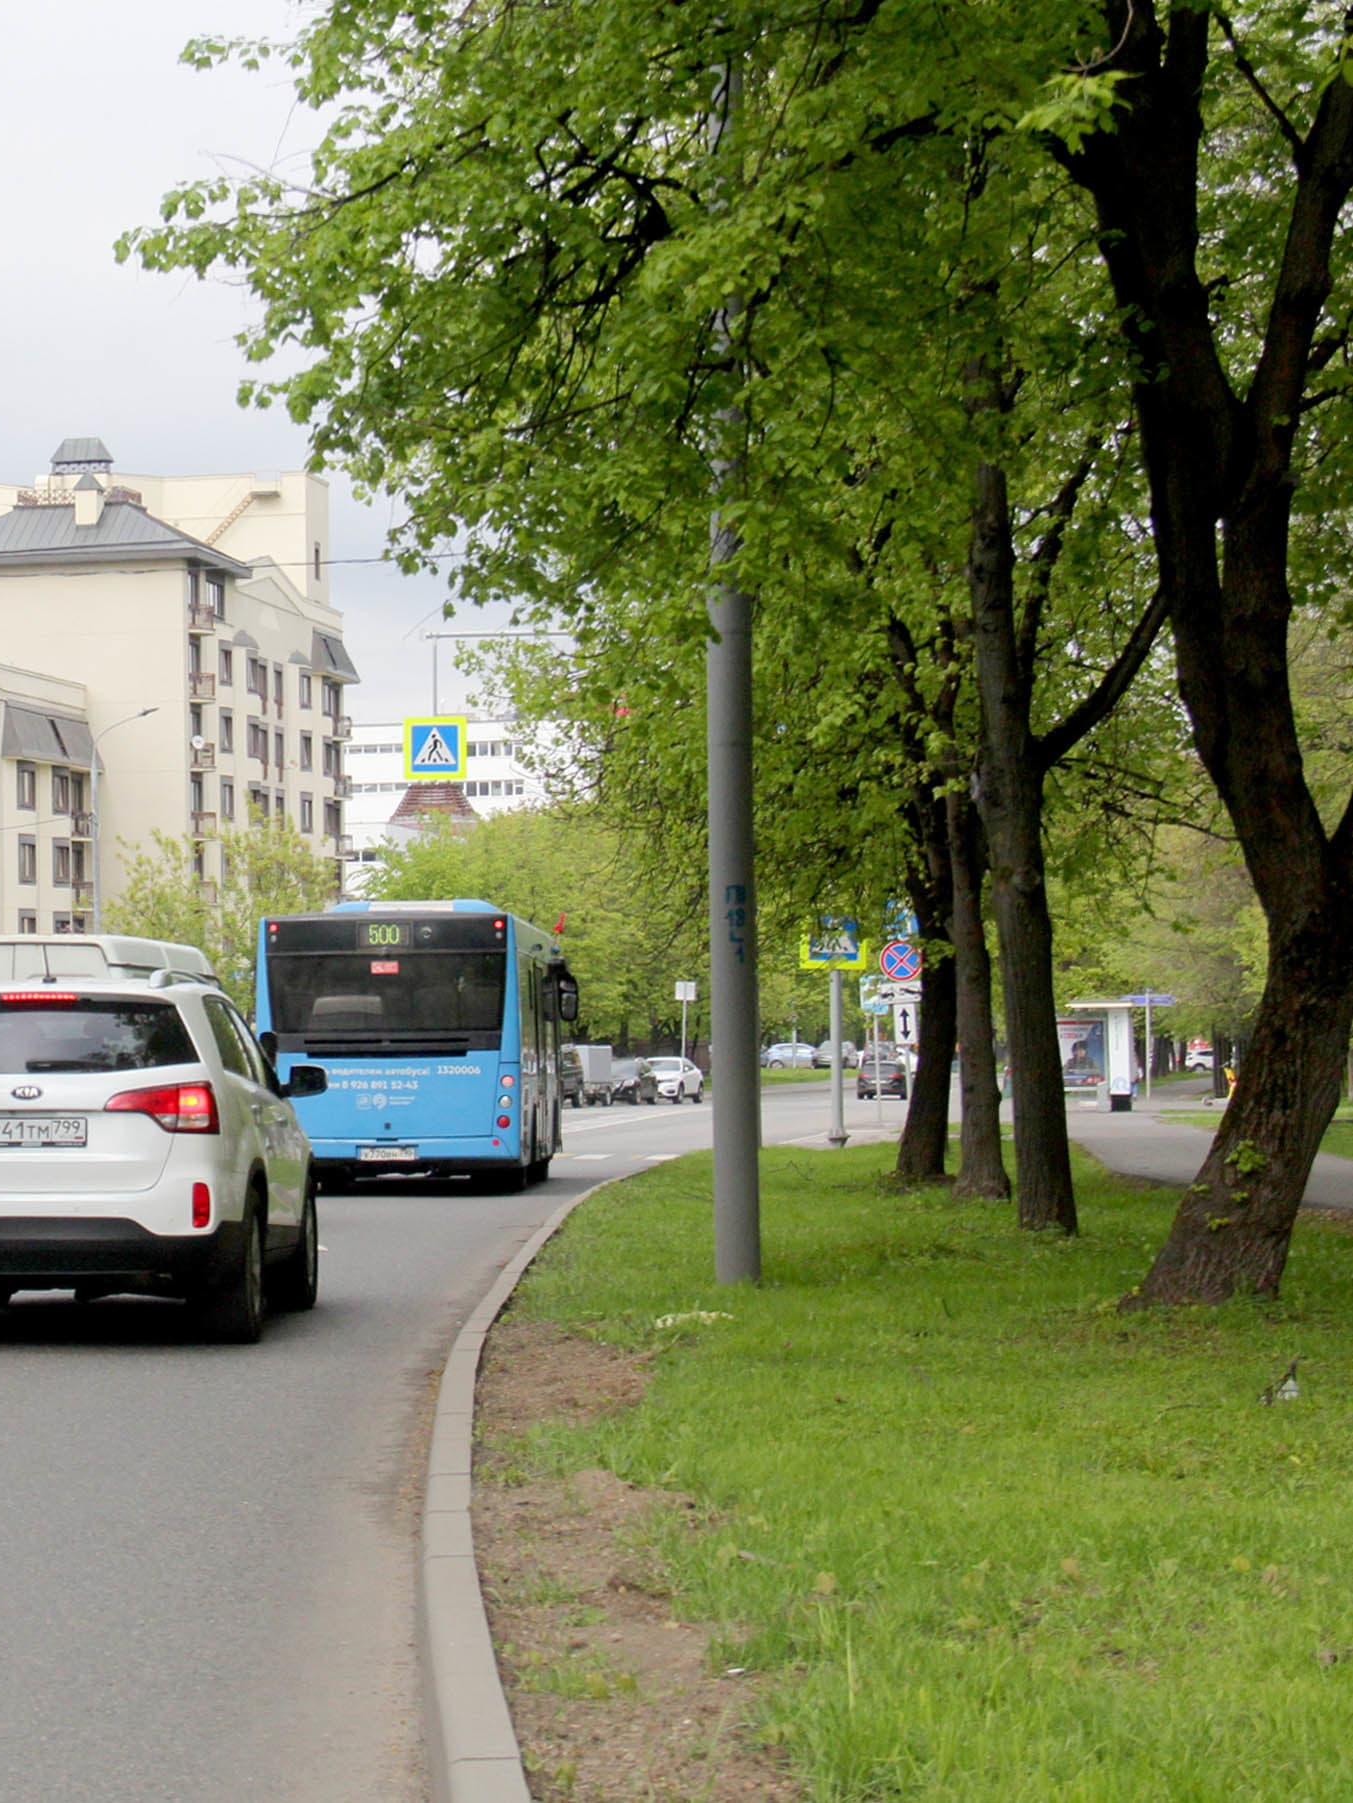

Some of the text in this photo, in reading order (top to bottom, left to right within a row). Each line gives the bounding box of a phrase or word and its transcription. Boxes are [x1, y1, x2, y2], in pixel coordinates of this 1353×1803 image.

[368, 923, 400, 945] 500
[15, 1087, 39, 1097] KIA
[52, 1120, 81, 1134] 799
